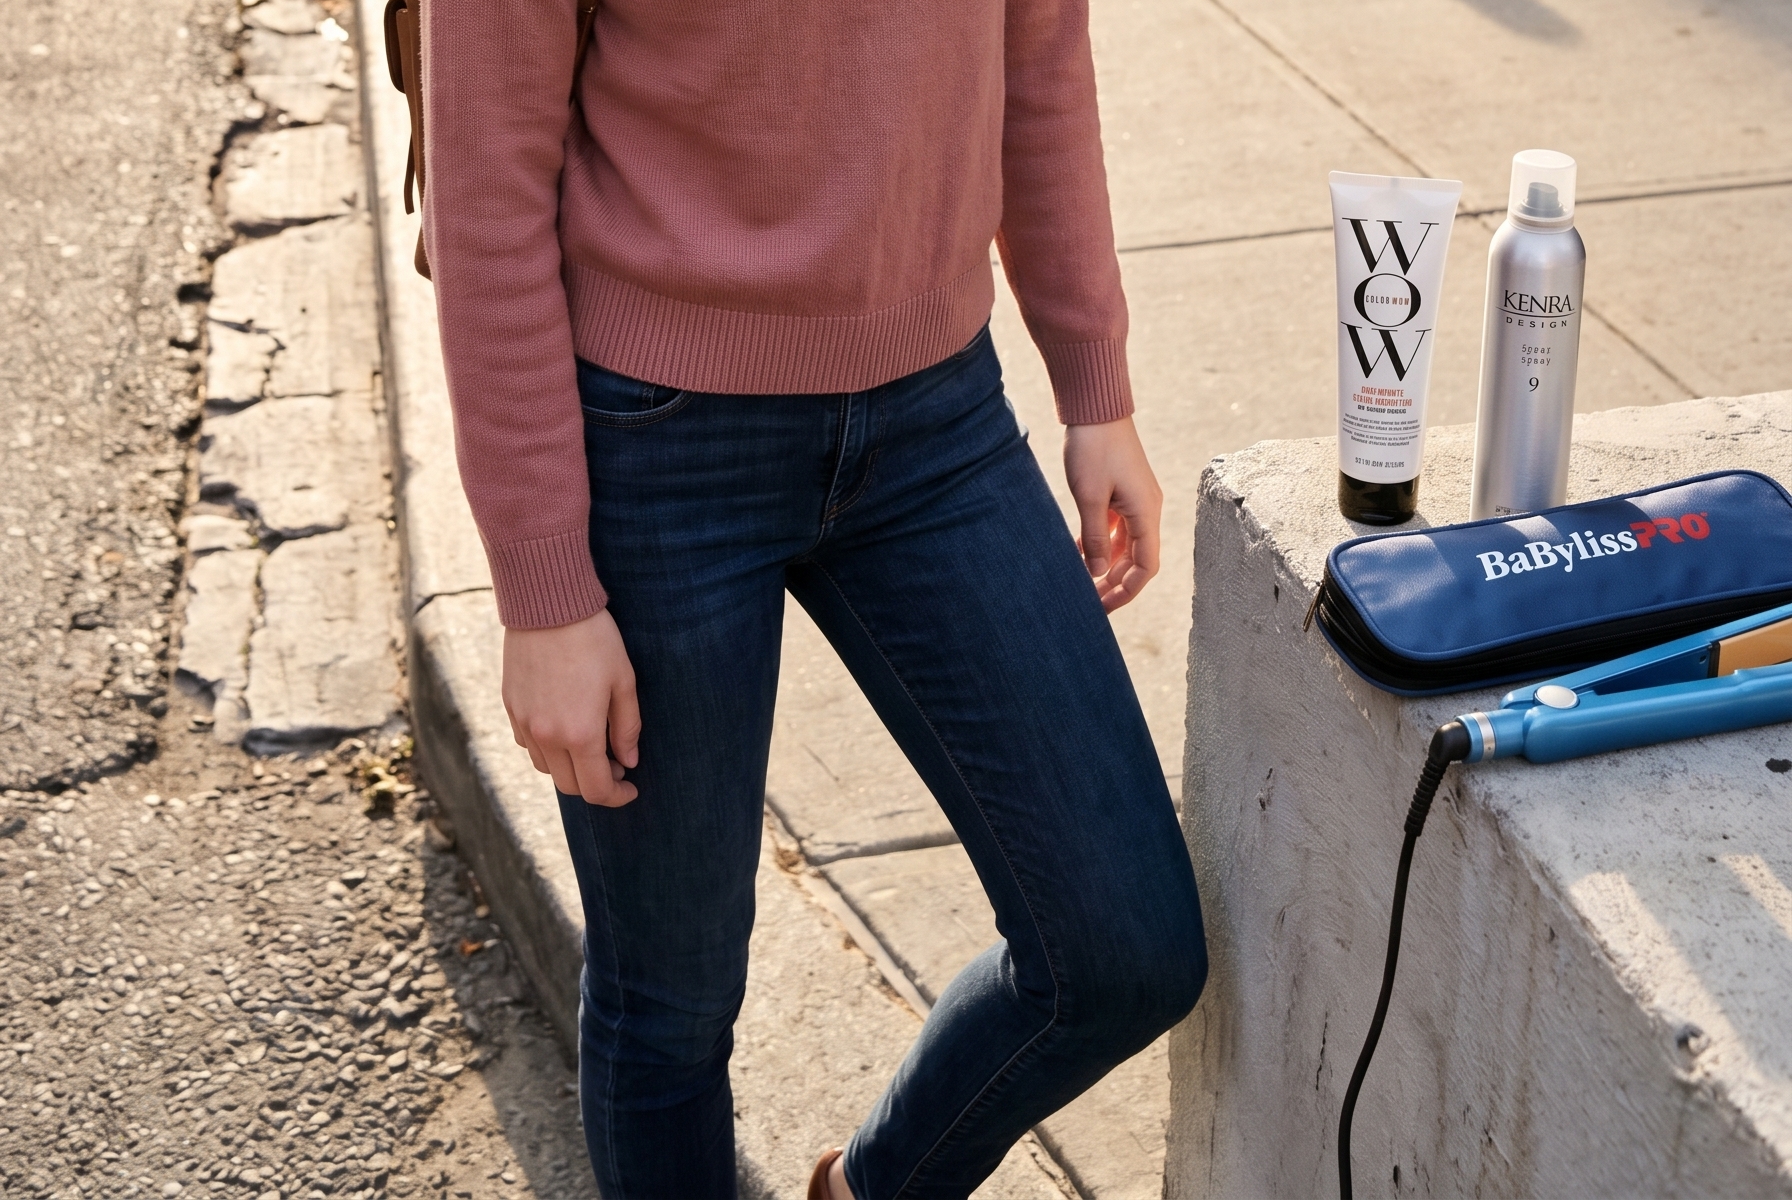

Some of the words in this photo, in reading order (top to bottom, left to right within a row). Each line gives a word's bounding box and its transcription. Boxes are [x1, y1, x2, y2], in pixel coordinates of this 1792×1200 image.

[1341, 217, 1439, 382] WOW
[1503, 289, 1573, 314] KENRA
[1505, 316, 1567, 328] DESIGN
[1528, 376, 1540, 393] 9
